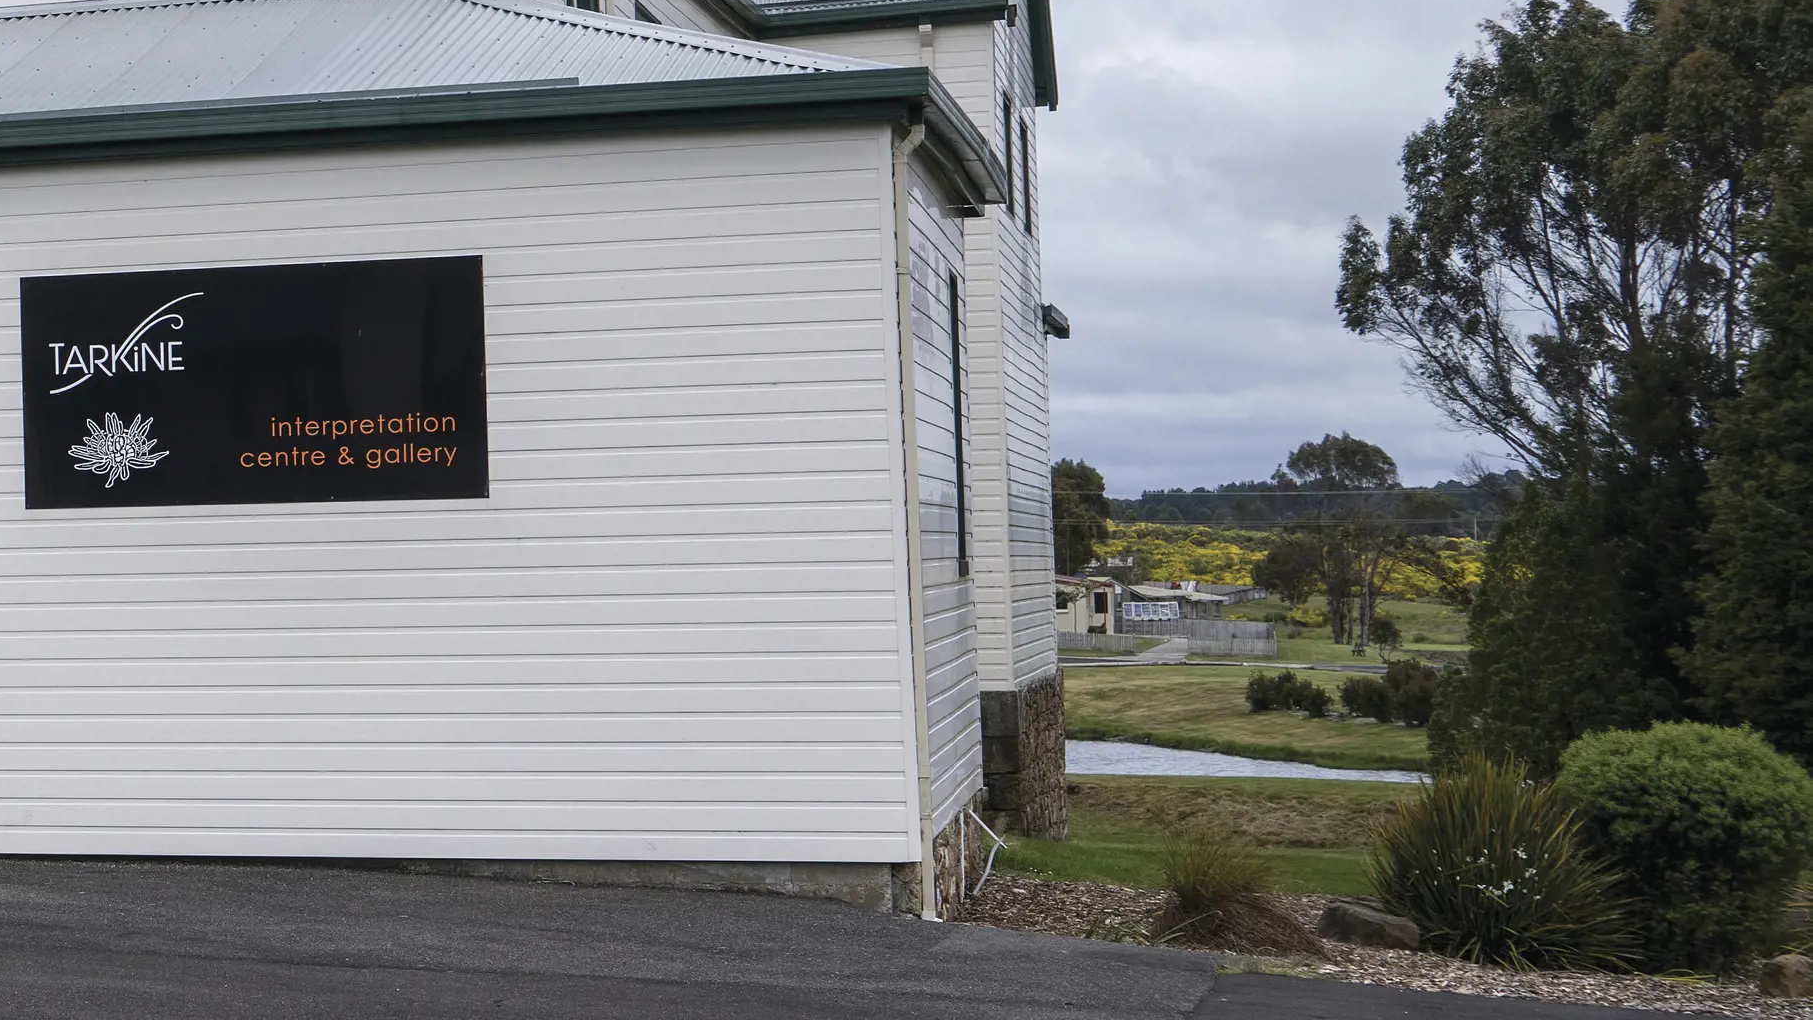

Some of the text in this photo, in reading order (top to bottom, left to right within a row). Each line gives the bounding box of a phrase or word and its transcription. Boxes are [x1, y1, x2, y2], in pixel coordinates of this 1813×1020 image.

[271, 412, 456, 440] interpretation
[239, 443, 457, 469] centre & gallery
